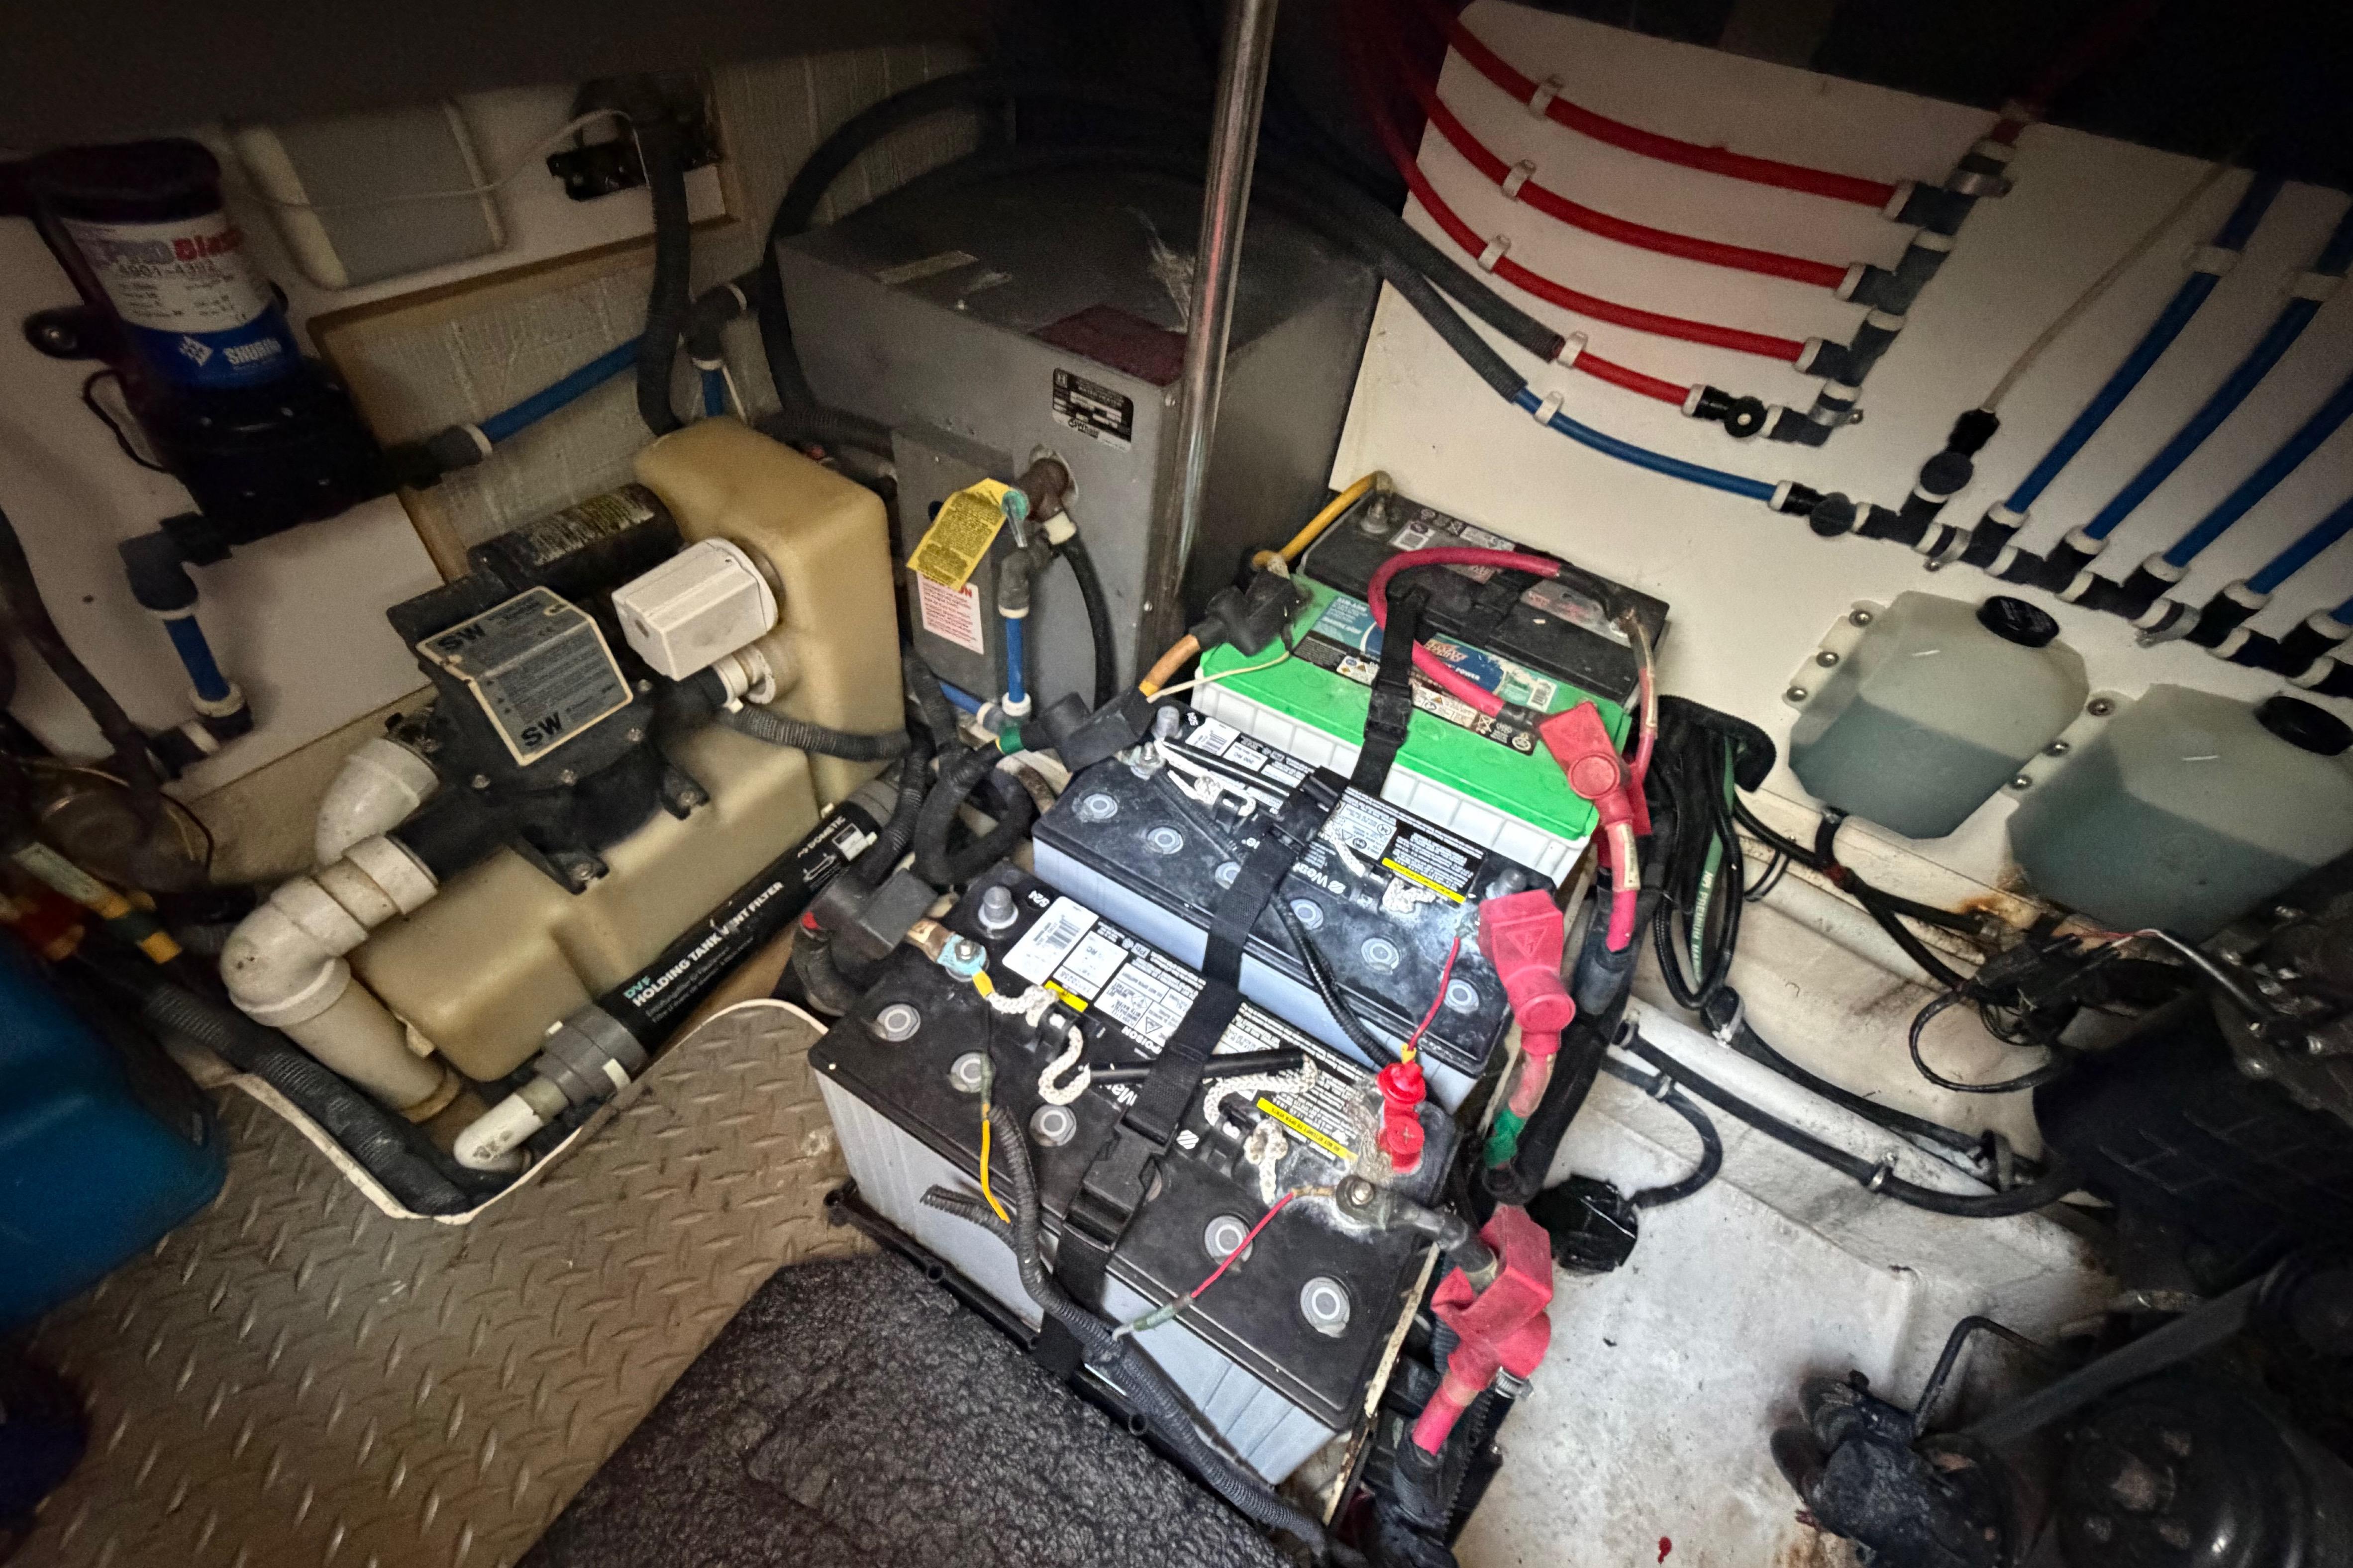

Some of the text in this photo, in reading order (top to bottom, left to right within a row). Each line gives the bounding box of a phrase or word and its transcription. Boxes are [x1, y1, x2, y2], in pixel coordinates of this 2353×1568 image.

[438, 625, 486, 651] SW
[1455, 667, 1480, 681] POWER
[521, 712, 562, 747] SW
[807, 816, 846, 850] DOMETIC
[1292, 862, 1328, 887] West
[1028, 890, 1050, 907] 5/24
[1692, 891, 1709, 940] PREMIUM
[632, 957, 691, 1008] HOLDING
[689, 931, 724, 966] TANK
[749, 881, 785, 913] FILTER
[1084, 945, 1098, 956] RC
[1133, 945, 1147, 956] Pb
[623, 975, 652, 999] DVF
[1283, 1115, 1298, 1126] OPEN
[1302, 1126, 1325, 1143] ATTEMPT
[1322, 1139, 1333, 1148] NOT
